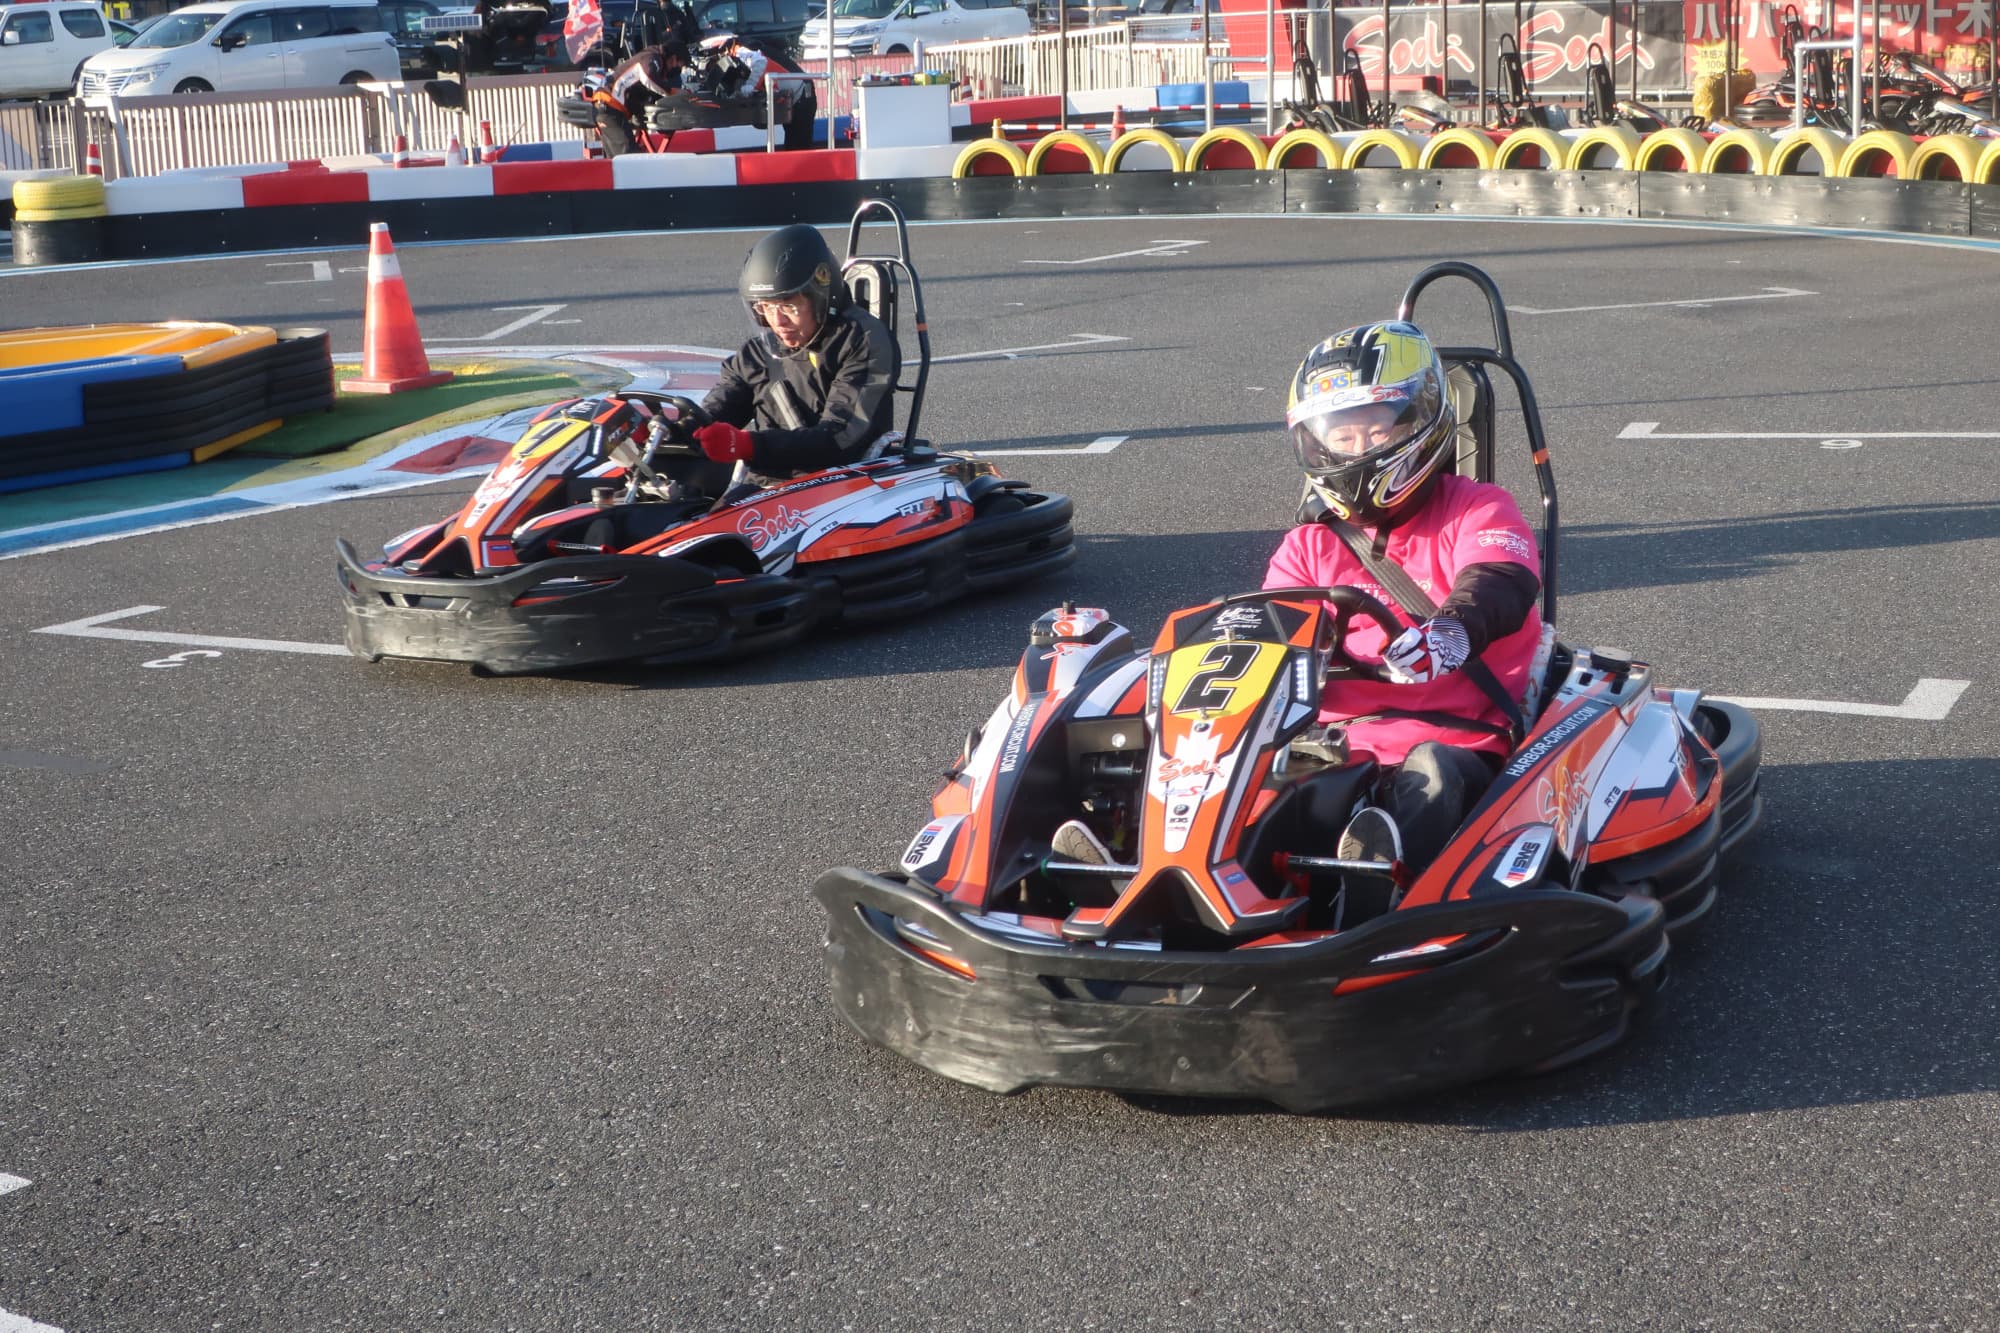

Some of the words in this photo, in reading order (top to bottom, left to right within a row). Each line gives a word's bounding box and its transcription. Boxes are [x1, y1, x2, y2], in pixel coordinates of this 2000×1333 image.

[736, 504, 810, 552] Sodi
[1168, 642, 1262, 715] 2
[1506, 705, 1600, 777] HARBOR-CIRCUIT.COM
[904, 834, 936, 866] SWS
[1513, 841, 1541, 869] SWS
